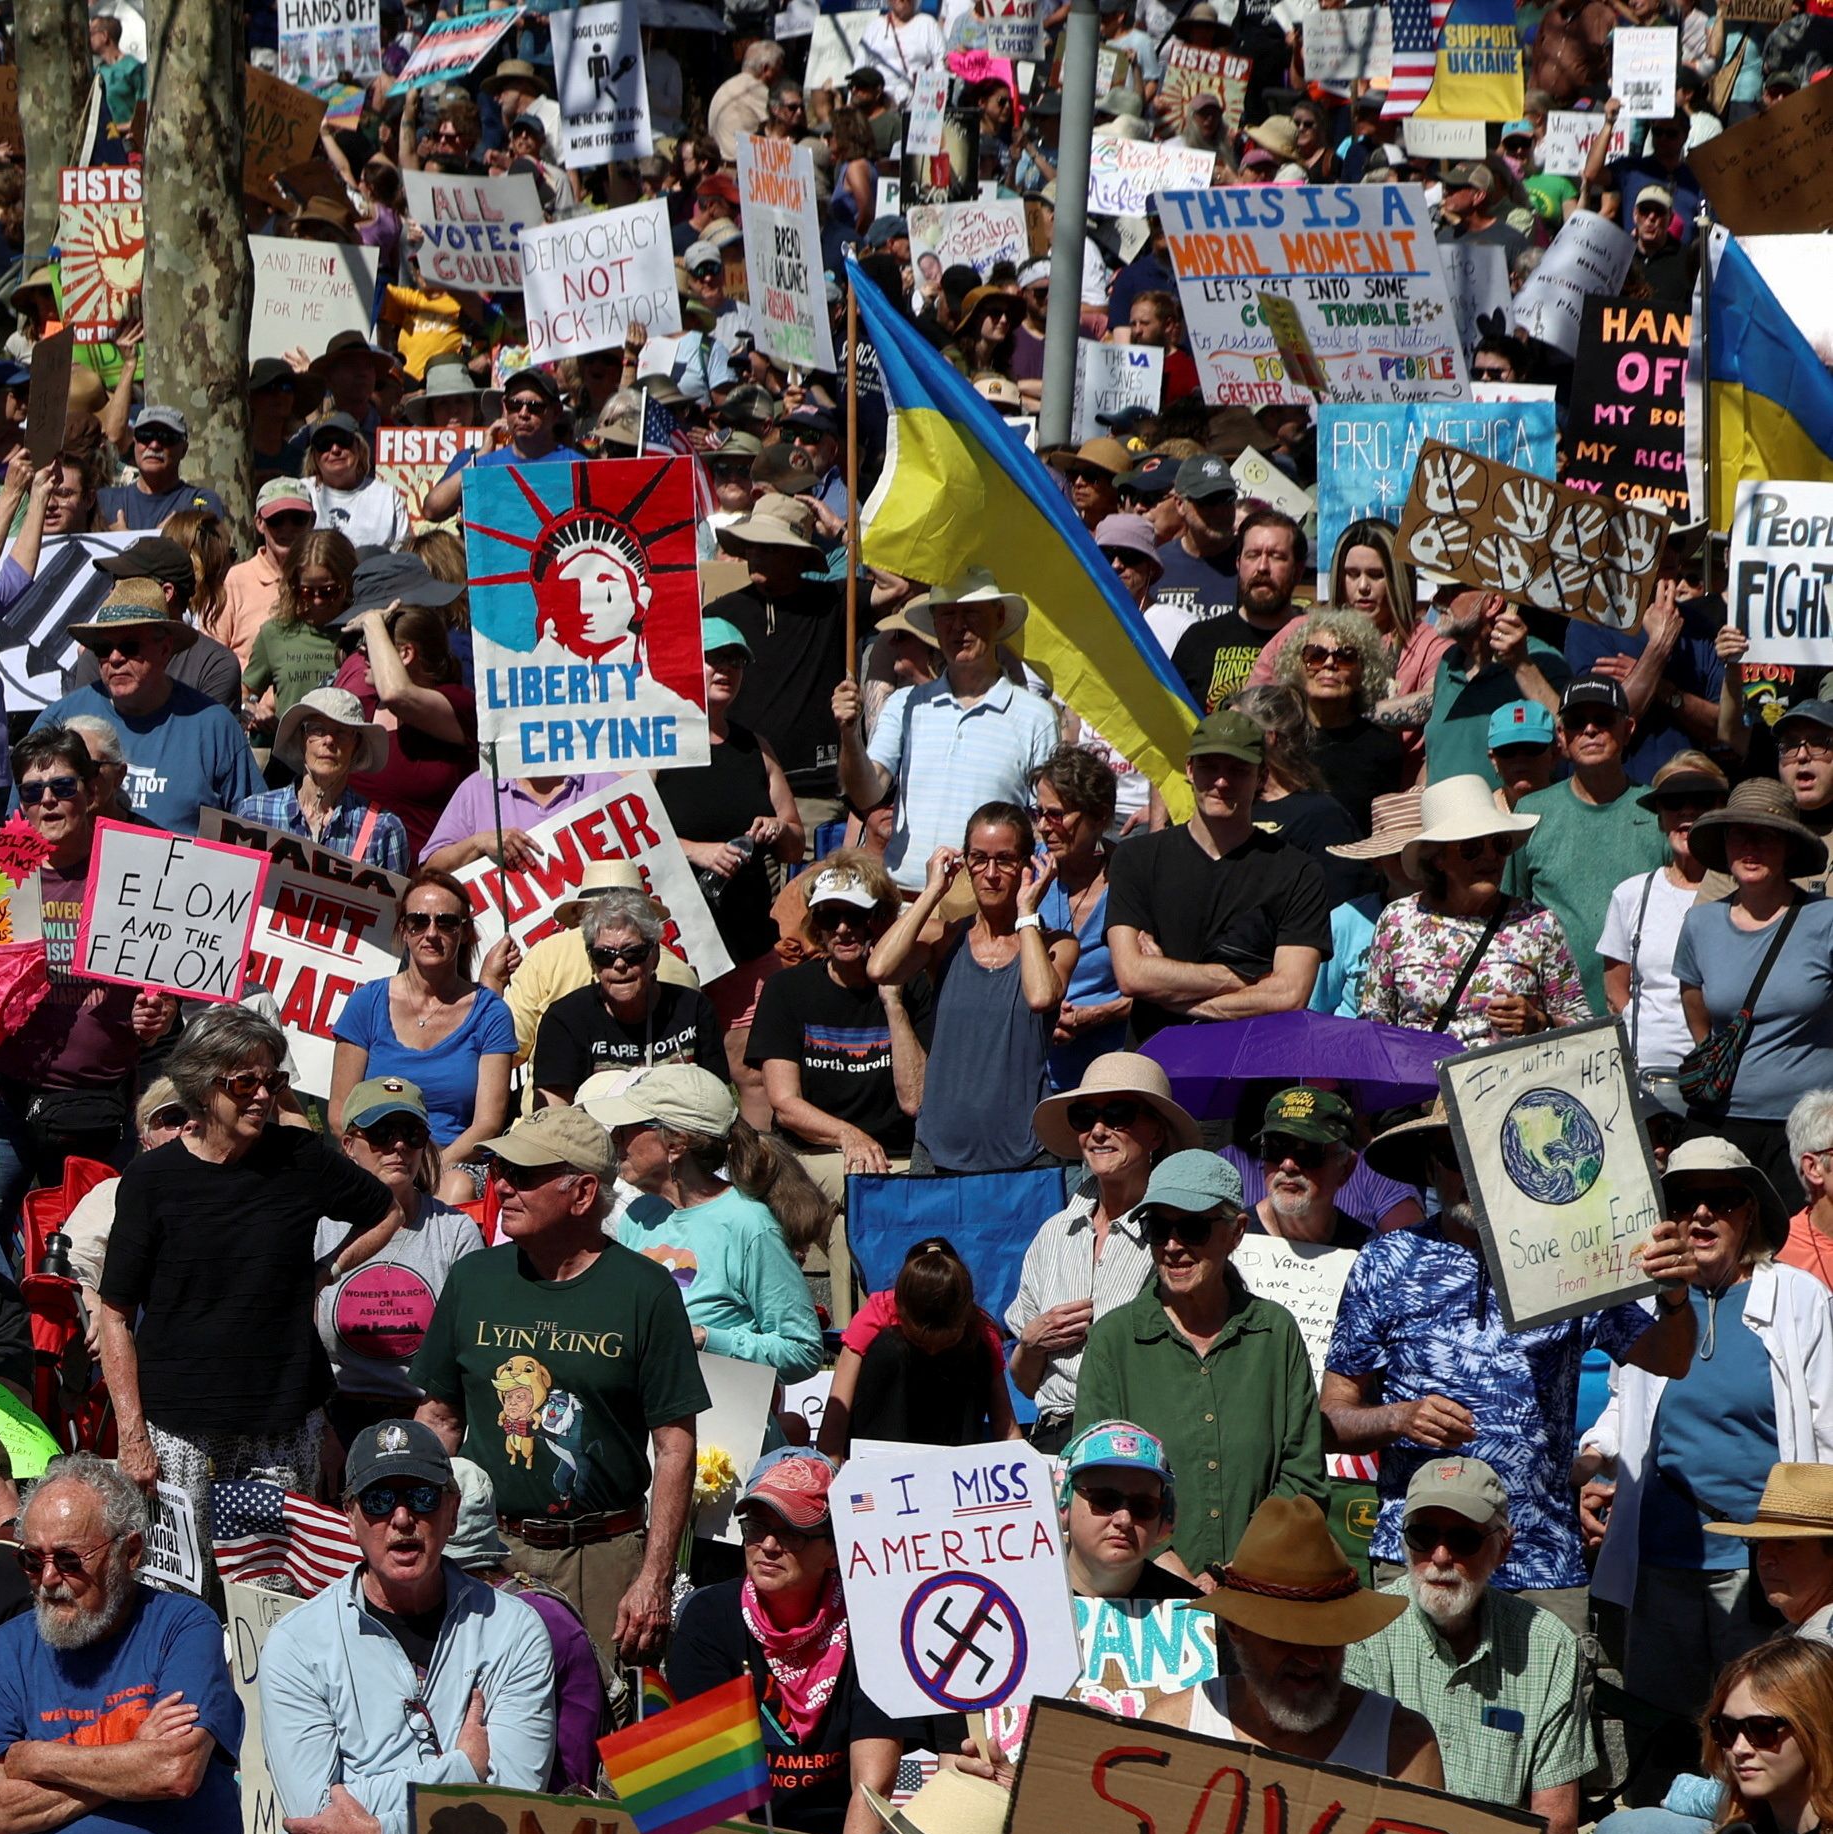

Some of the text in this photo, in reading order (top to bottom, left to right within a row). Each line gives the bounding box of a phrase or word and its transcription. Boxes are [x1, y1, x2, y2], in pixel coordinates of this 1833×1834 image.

[1445, 25, 1518, 48] SUPPORT
[1448, 49, 1518, 77] UKRAINE
[523, 212, 660, 274] DEMOCRACY
[1170, 231, 1415, 277] MORAL MOMENT
[563, 258, 633, 305] NOT
[487, 664, 642, 708] LIBERTY
[521, 715, 677, 762] CRYING
[165, 838, 193, 874] F
[118, 875, 250, 922] ELON
[120, 916, 222, 952] AND THE
[87, 936, 240, 993] FELON
[534, 1321, 560, 1333] THE
[550, 1332, 624, 1358] KING
[894, 1463, 1029, 1515] I MISS
[849, 1521, 1054, 1578] AMERICA
